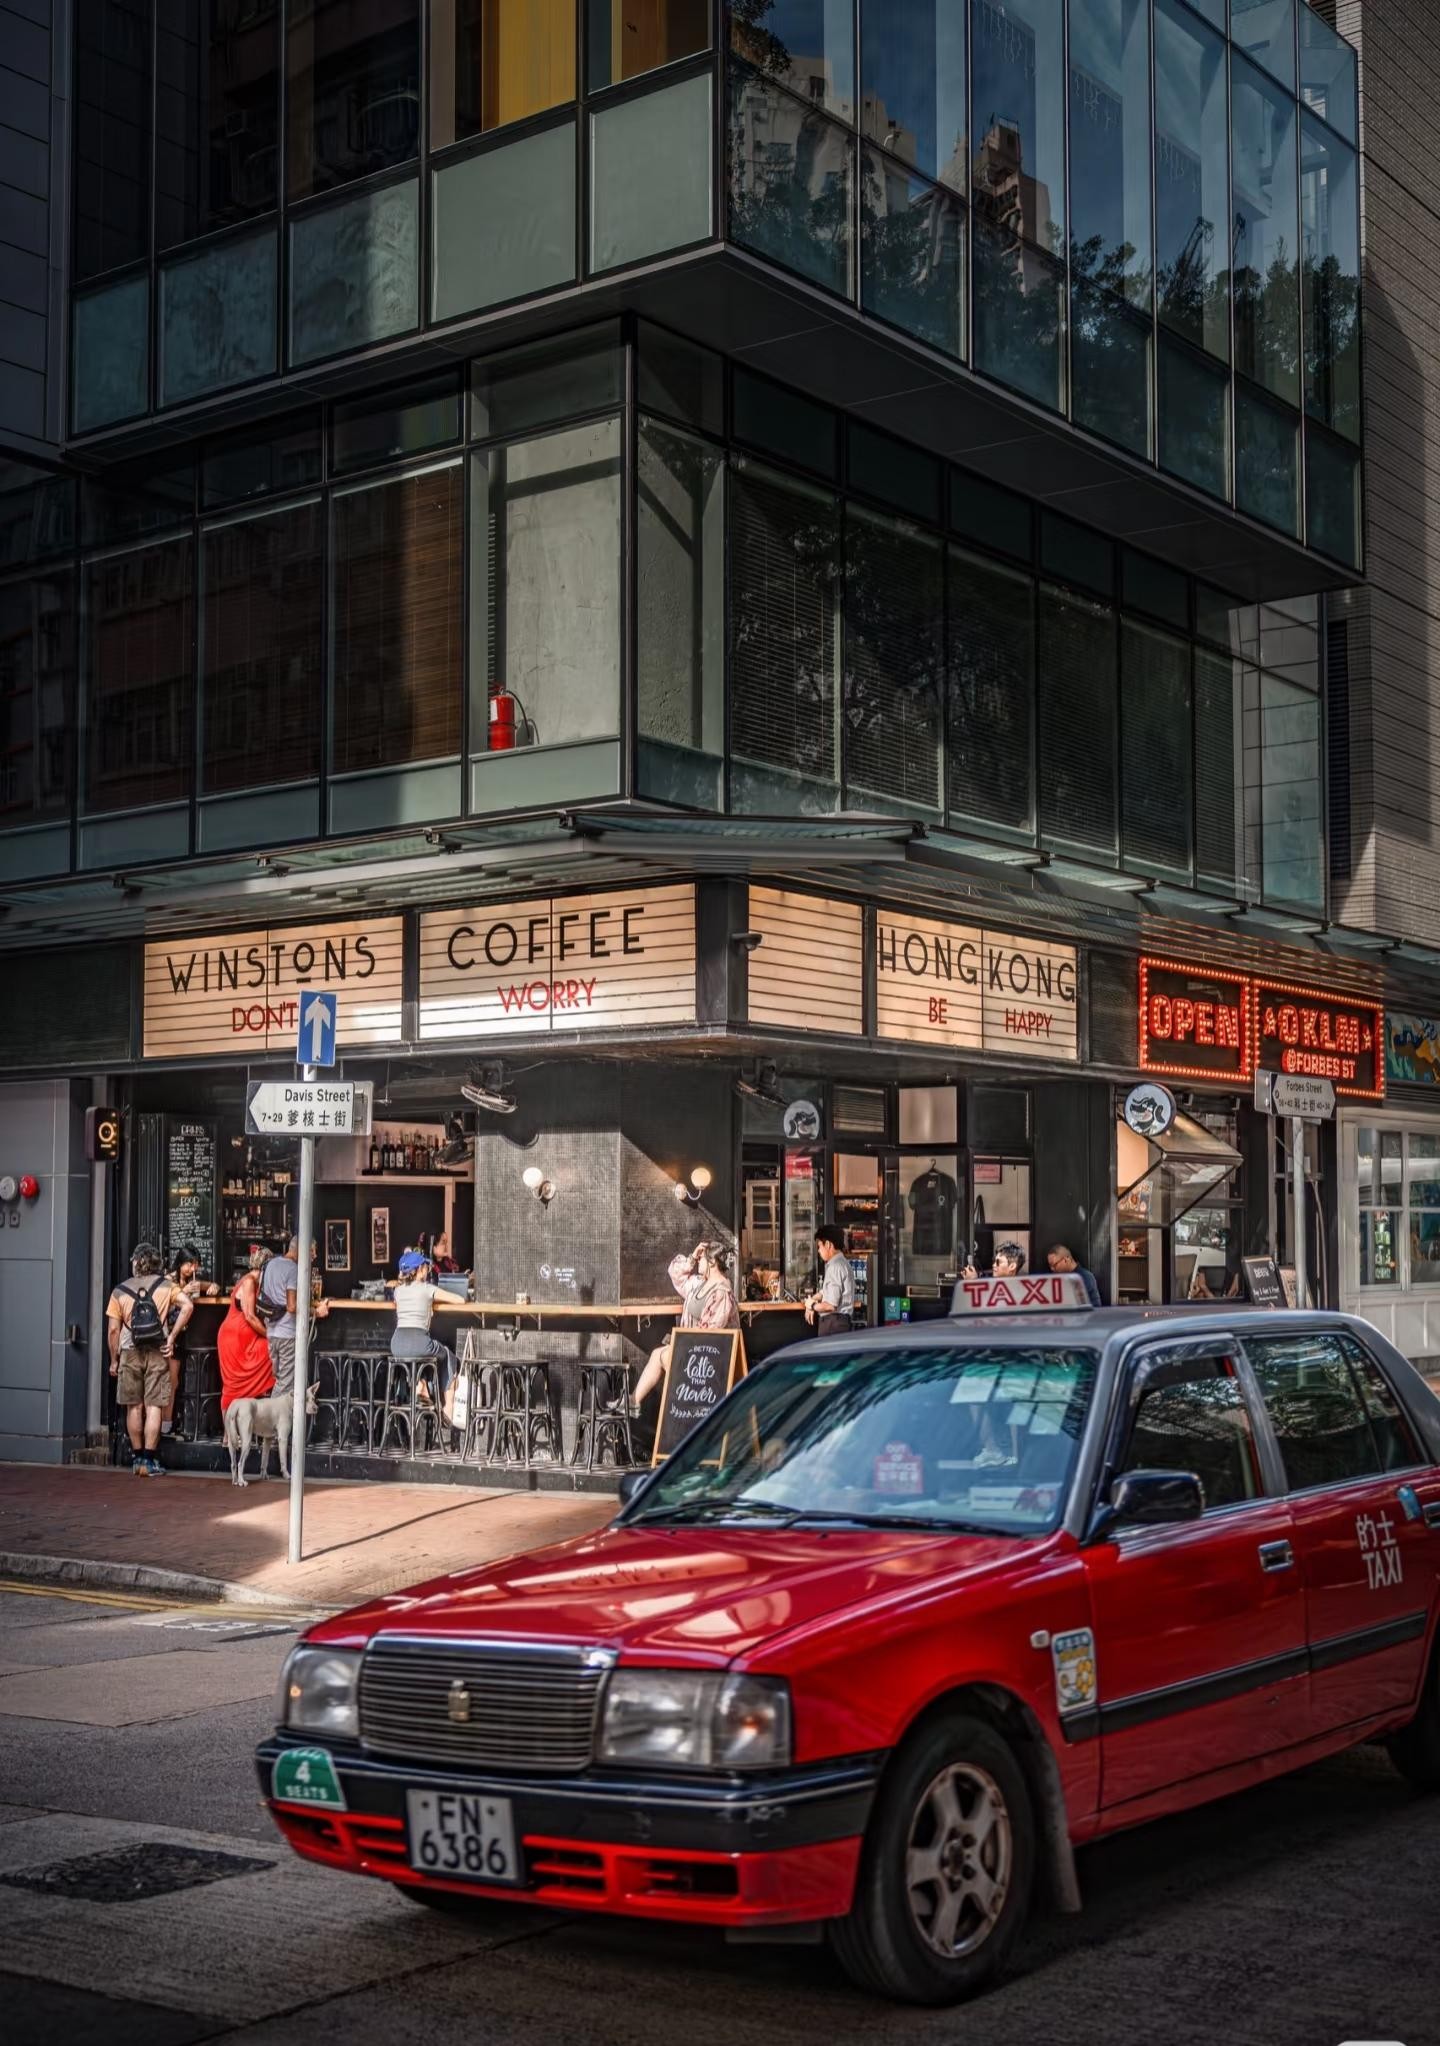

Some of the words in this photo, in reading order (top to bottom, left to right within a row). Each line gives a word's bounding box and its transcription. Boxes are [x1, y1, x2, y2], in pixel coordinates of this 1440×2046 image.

[447, 907, 645, 970] COFFEE
[166, 935, 375, 993] WINSTONS
[879, 927, 977, 985] HONG
[989, 948, 1075, 1002] KONG
[497, 977, 597, 1013] WORRY
[928, 997, 947, 1025] BE
[231, 1001, 299, 1033] DON'T
[1005, 1008, 1053, 1038] HAPPY
[1149, 994, 1240, 1048] OPEN
[1278, 1005, 1360, 1054] OKLM
[1282, 1048, 1340, 1077] @FORBES
[1341, 1059, 1356, 1079] ST
[285, 1088, 313, 1102] Davis
[317, 1088, 350, 1102] Street
[1286, 1080, 1304, 1092] Forbes
[1305, 1081, 1322, 1094] Street
[963, 1278, 1062, 1307] TAXI
[693, 1345, 718, 1355] BETTER
[691, 1377, 706, 1385] THAN
[1355, 1510, 1397, 1550] 的士
[1361, 1546, 1403, 1589] TAXI
[295, 1760, 311, 1784] 4
[285, 1785, 328, 1799] SEATS
[437, 1794, 482, 1835] FN
[420, 1830, 507, 1875] 6386
